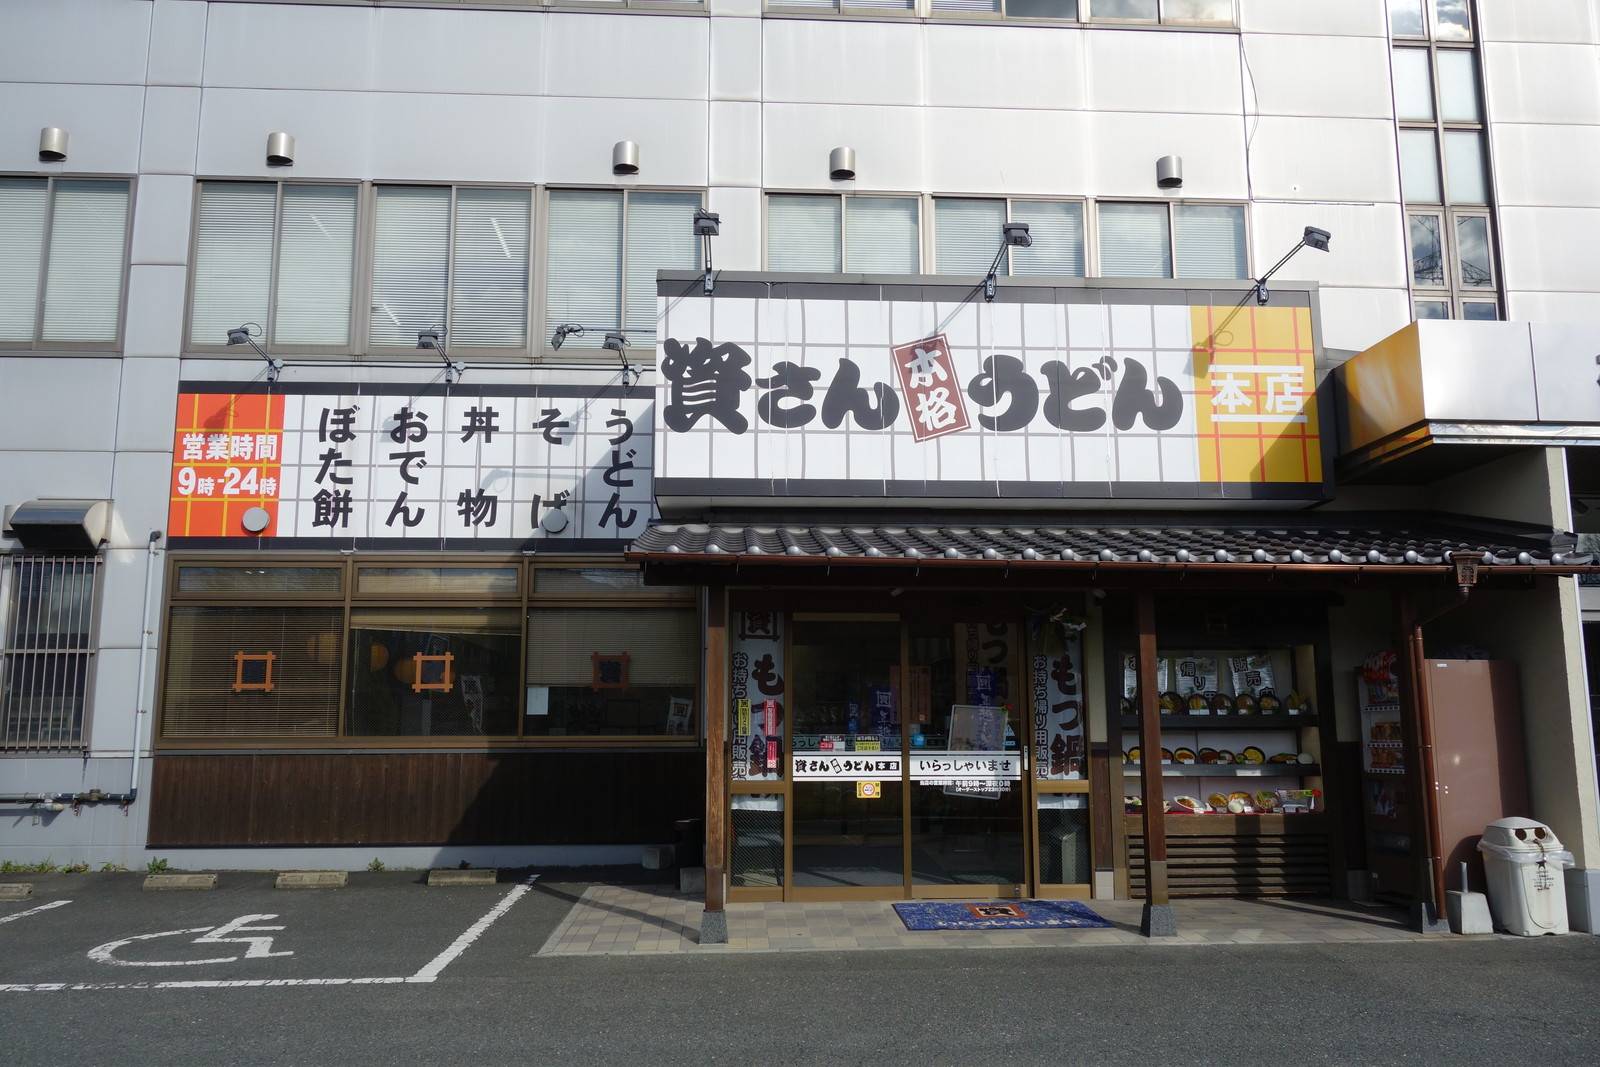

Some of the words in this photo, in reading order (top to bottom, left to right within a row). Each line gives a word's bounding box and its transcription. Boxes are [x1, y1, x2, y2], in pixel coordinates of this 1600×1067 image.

[663, 336, 900, 435] 資さん
[904, 346, 957, 432] 本格
[967, 353, 1184, 433] うどん
[1210, 371, 1306, 413] 本店
[182, 433, 278, 462] 営業時間
[311, 405, 361, 529] ぼた餅
[385, 406, 429, 528] おでん
[456, 405, 500, 529] 丼物
[598, 408, 638, 529] うどん
[919, 760, 1011, 772] いらっしゃいませ
[1050, 654, 1086, 777] もつ鍋
